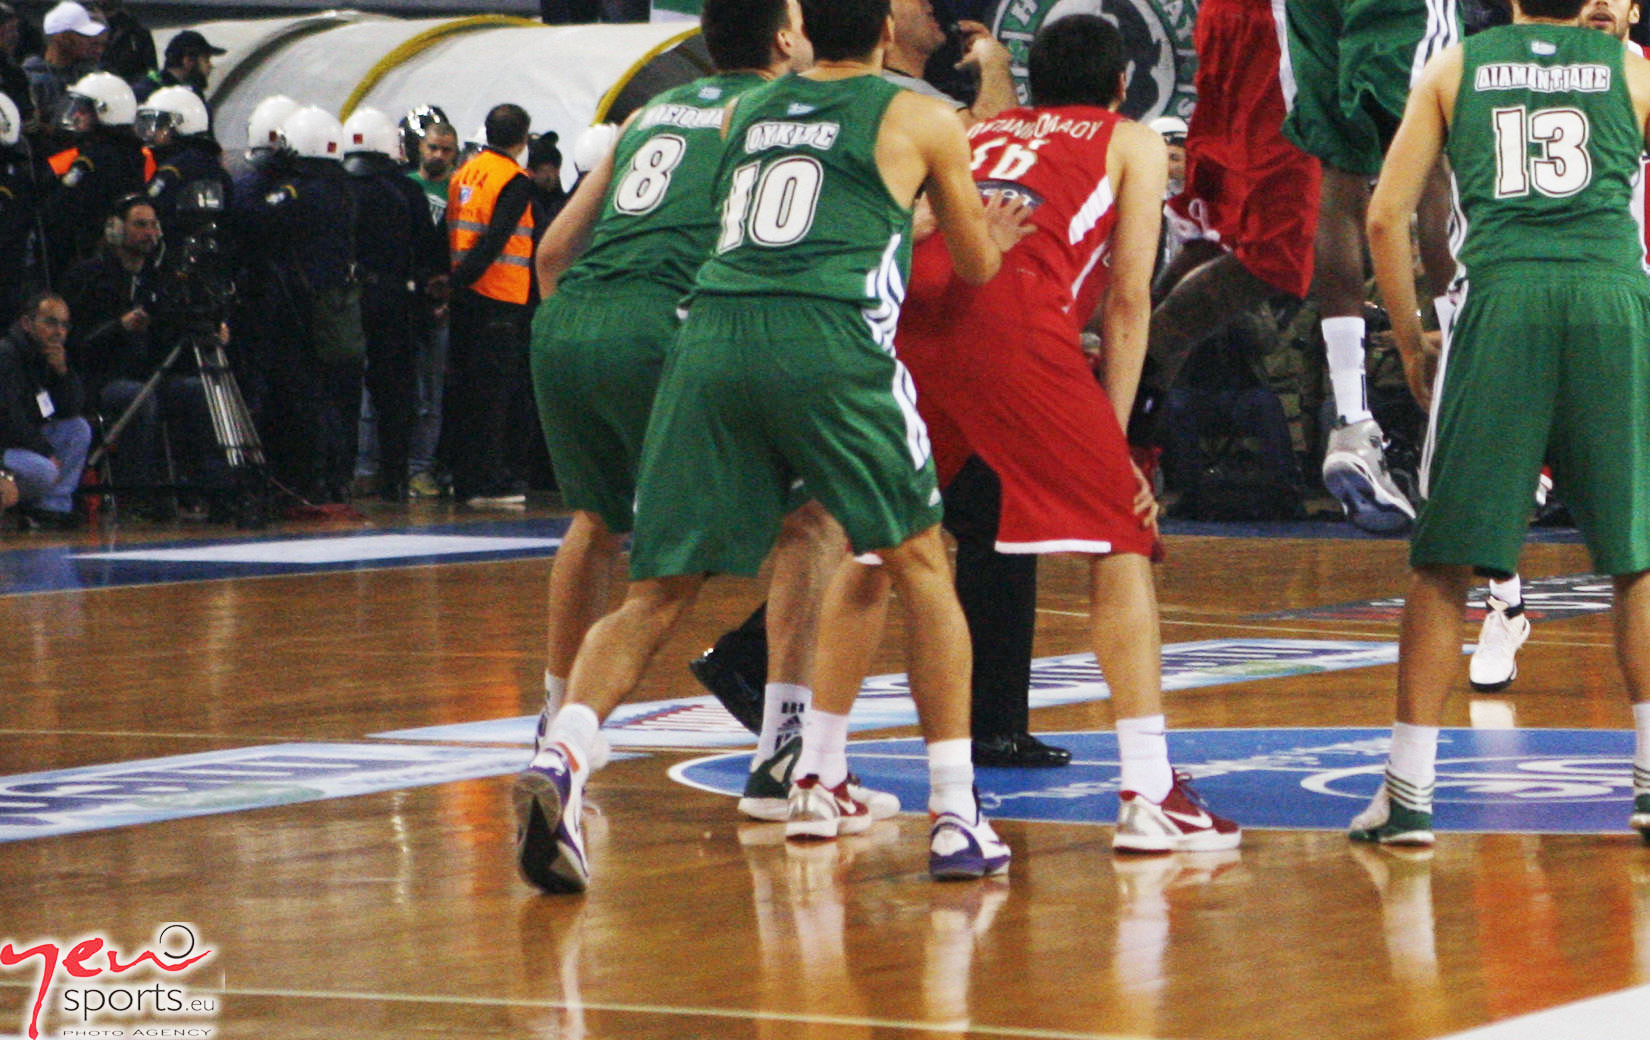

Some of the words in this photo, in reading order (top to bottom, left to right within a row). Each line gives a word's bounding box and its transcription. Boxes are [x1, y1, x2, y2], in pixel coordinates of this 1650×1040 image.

[614, 132, 686, 216] 8
[1493, 105, 1592, 199] 13
[717, 154, 824, 255] 10
